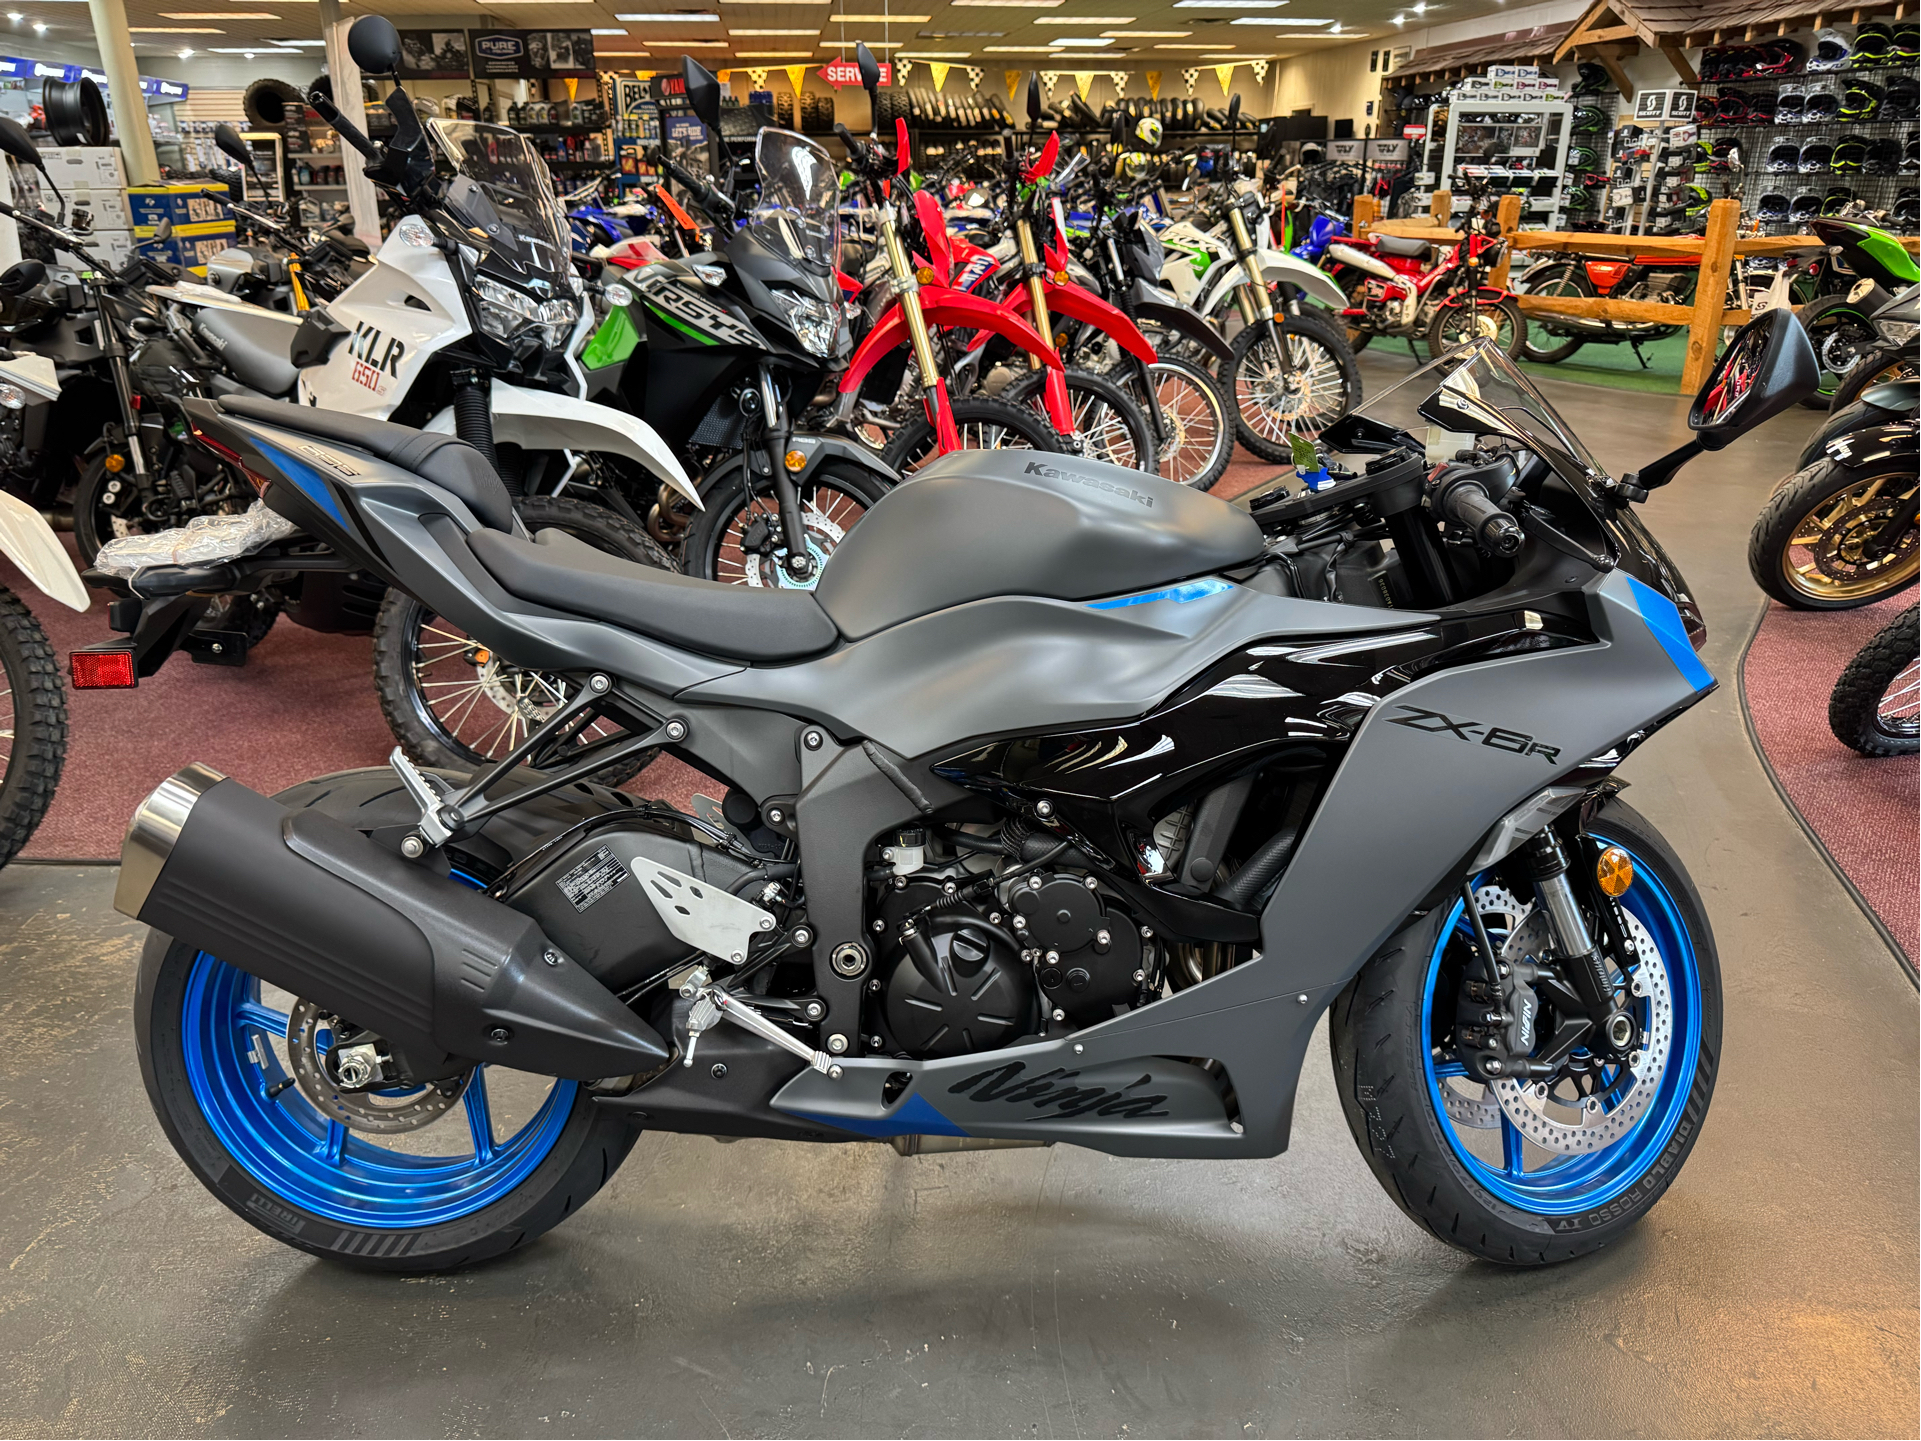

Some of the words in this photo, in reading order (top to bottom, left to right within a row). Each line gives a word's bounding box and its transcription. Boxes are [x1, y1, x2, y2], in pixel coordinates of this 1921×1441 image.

[482, 41, 517, 50] PURE
[669, 78, 686, 95] YAM
[827, 66, 888, 83] SERVE
[348, 320, 405, 380] KLR
[351, 361, 380, 392] 650
[1024, 461, 1154, 508] Kawasaki
[1384, 705, 1562, 766] ZX-6R
[1590, 955, 1612, 994] SHOWA
[947, 1060, 1170, 1122] Ninja
[1642, 1119, 1693, 1190] DIABLO
[246, 1193, 306, 1235] PIRELLI
[1555, 1217, 1582, 1231] IV
[1588, 1187, 1644, 1227] ROSSO
